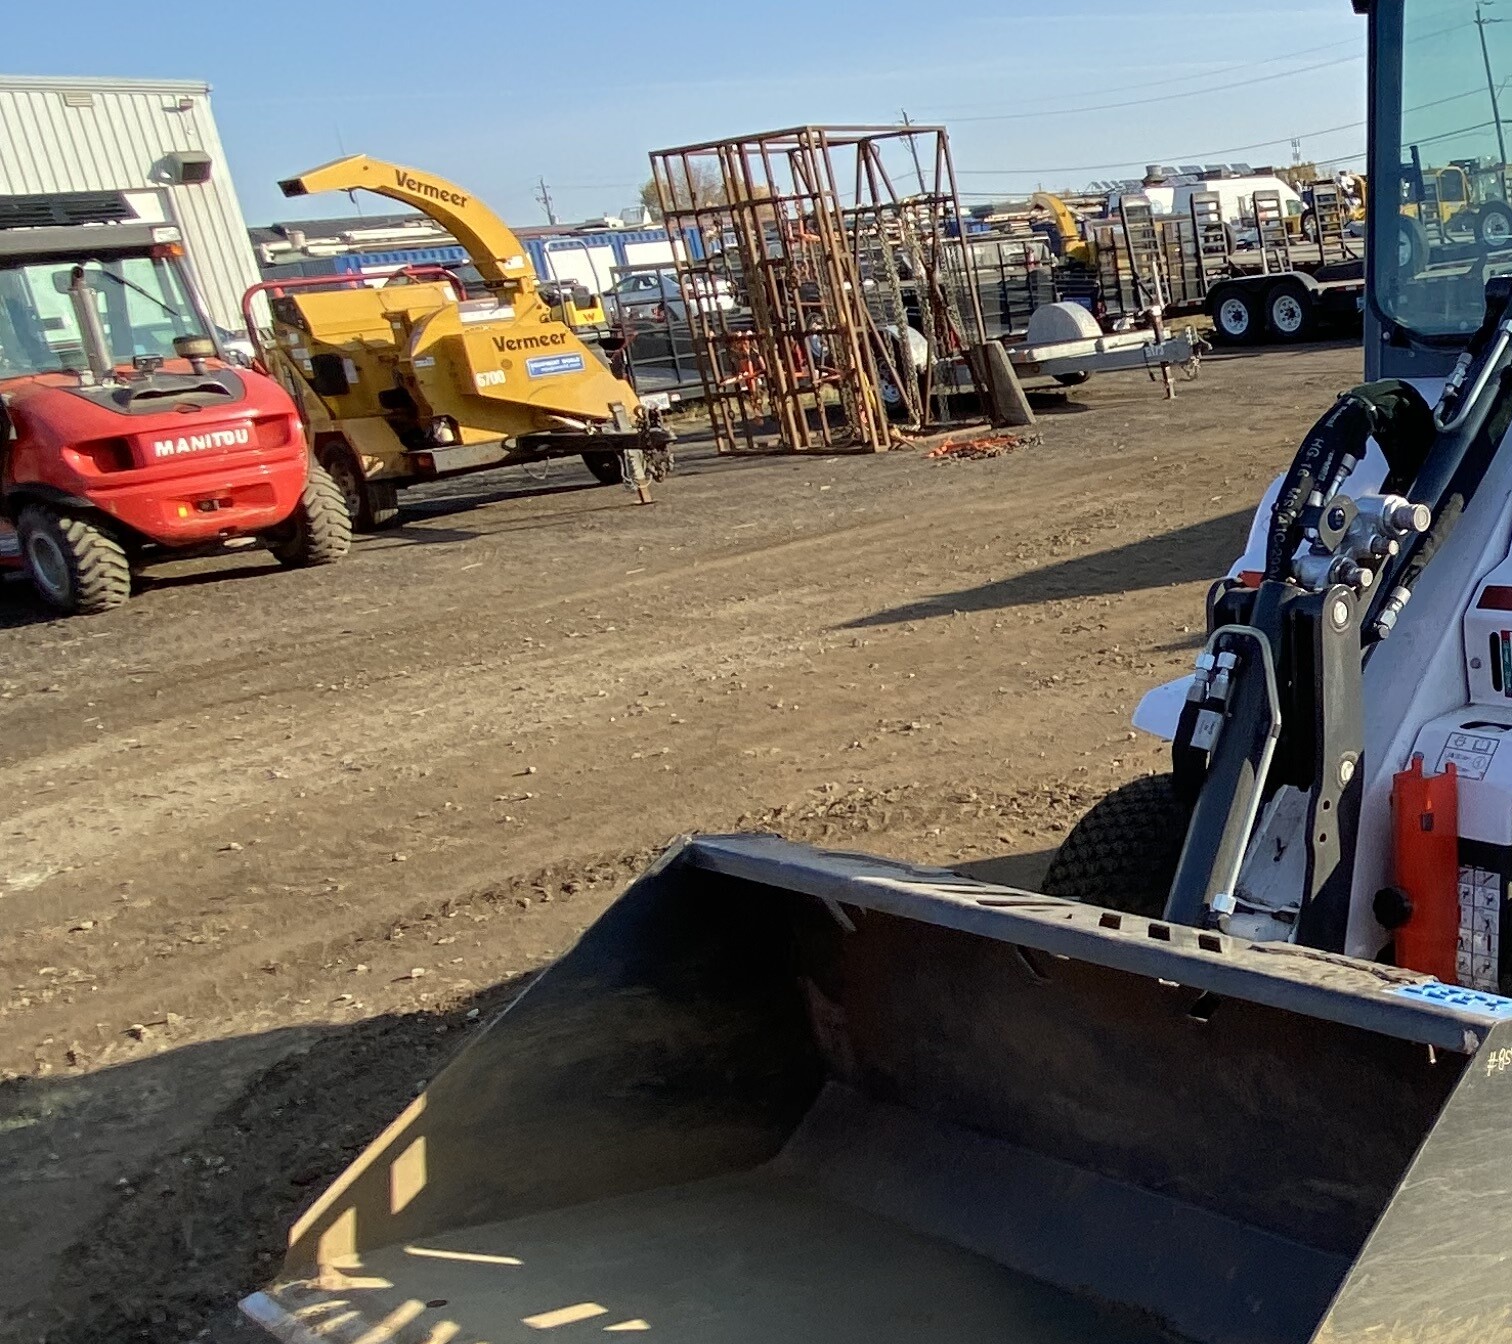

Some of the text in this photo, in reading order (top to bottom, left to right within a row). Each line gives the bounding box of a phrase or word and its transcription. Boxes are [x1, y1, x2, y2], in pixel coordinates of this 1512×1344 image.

[395, 169, 467, 207] Vermeer
[492, 333, 566, 352] Vermeer
[154, 429, 249, 456] MANITOU
